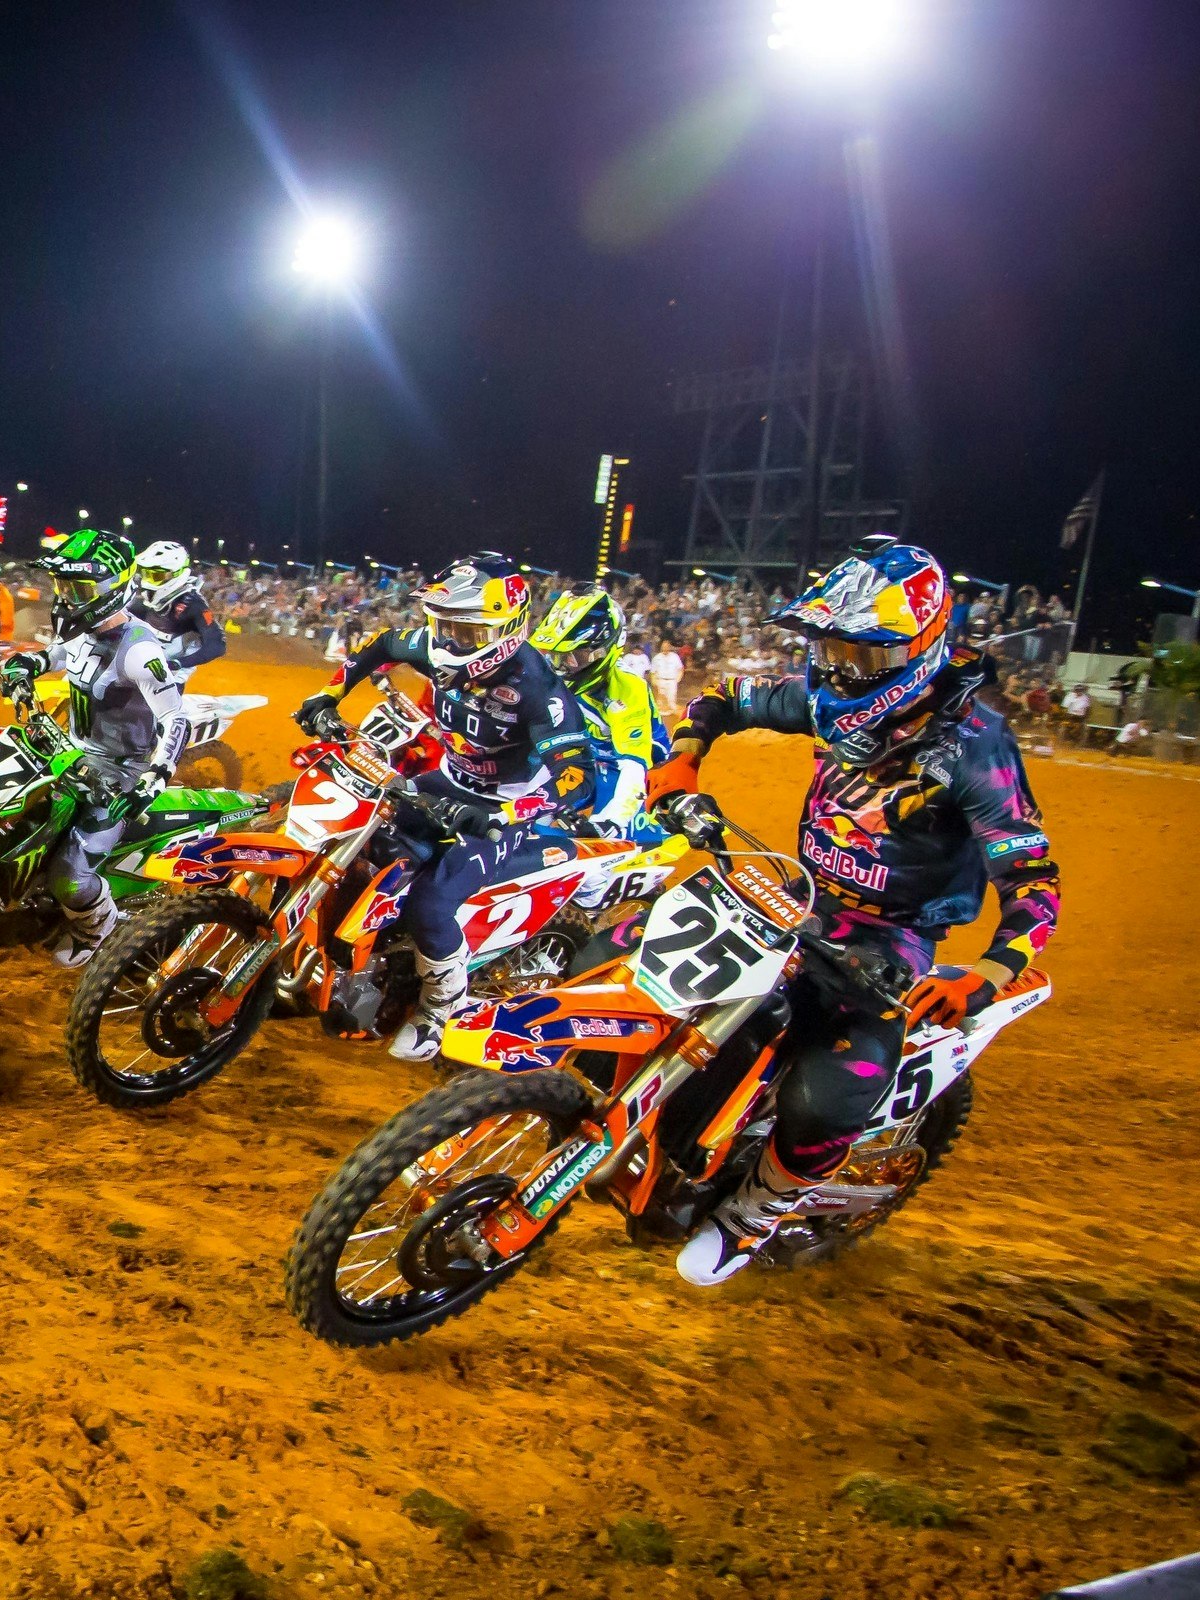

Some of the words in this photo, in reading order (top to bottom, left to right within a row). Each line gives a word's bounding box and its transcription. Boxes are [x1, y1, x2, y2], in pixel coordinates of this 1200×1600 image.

[221, 808, 255, 824] DUNLOP
[290, 780, 359, 839] 2
[803, 831, 838, 873] Red
[837, 849, 889, 892] Bull
[601, 872, 647, 909] 46
[733, 871, 796, 925] RENTHAL
[479, 893, 533, 954] 2
[641, 905, 765, 1001] 25
[571, 1018, 598, 1036] Red
[597, 1018, 623, 1036] Bull
[1011, 993, 1041, 1015] DUNLOP
[551, 1141, 613, 1201] MOTOREX
